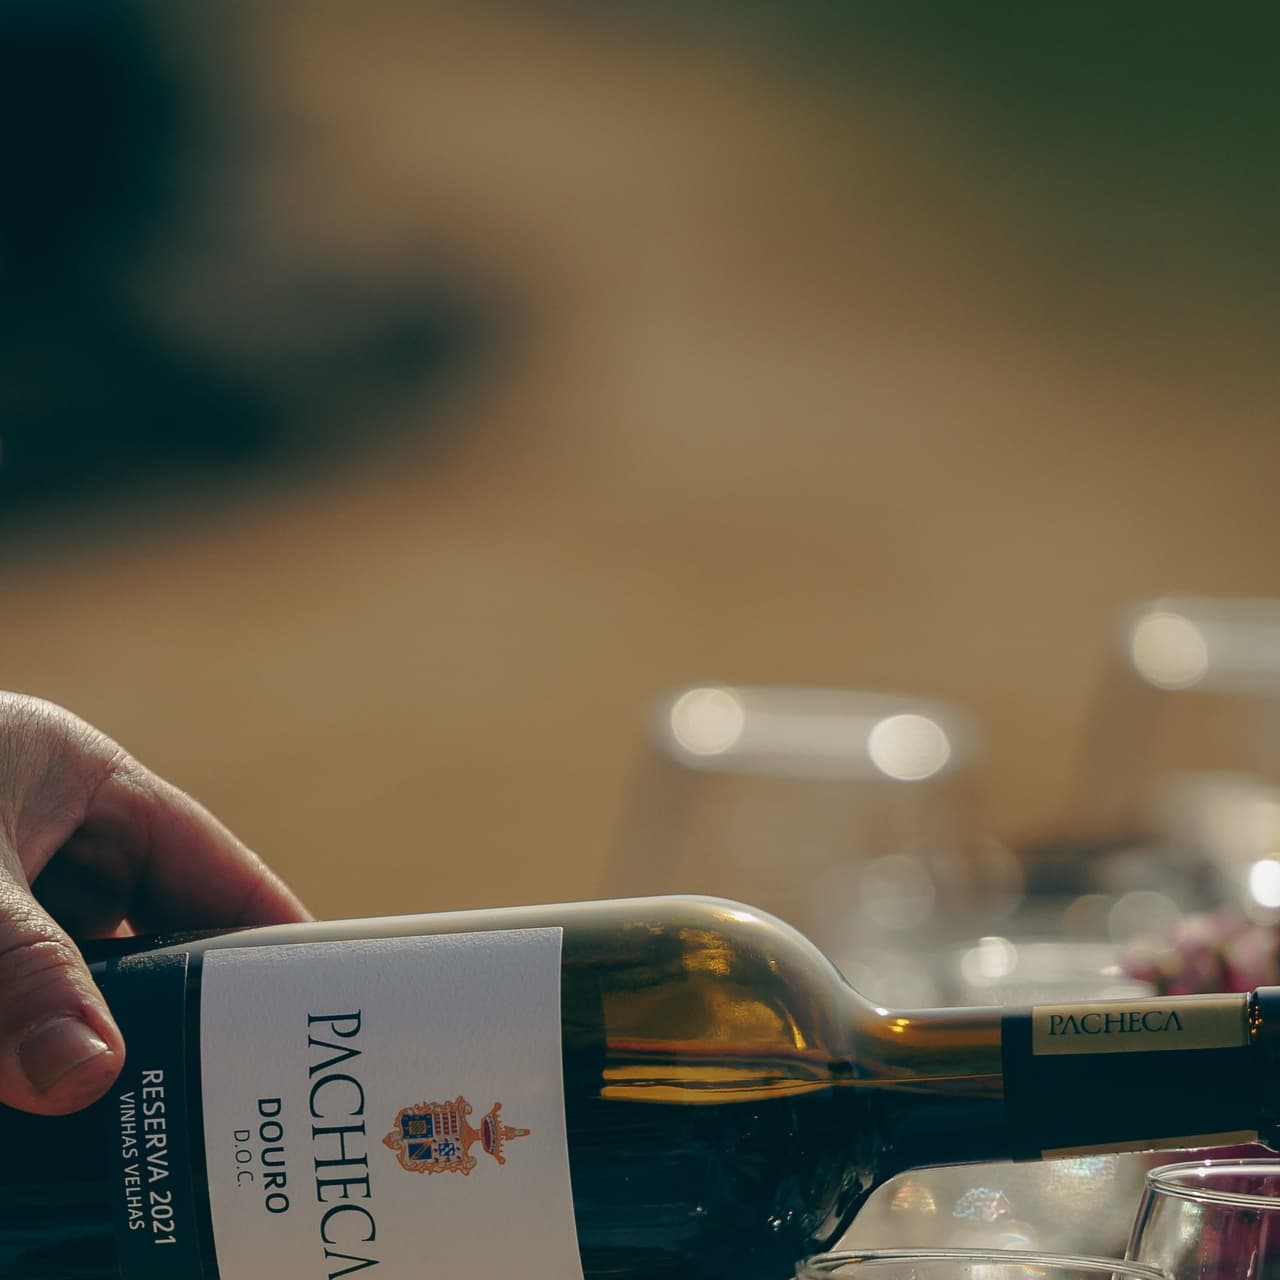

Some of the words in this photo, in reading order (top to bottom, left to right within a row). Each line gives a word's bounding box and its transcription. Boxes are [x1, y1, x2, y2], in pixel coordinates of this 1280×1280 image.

[1048, 1011, 1184, 1036] PACHECA
[120, 1092, 138, 1160] VINHAS
[142, 1069, 168, 1184] RESERVA
[233, 1129, 254, 1188] D.O.C.
[258, 1098, 290, 1214] DOURO
[124, 1164, 145, 1231] VELHAS
[150, 1191, 176, 1245] 2021
